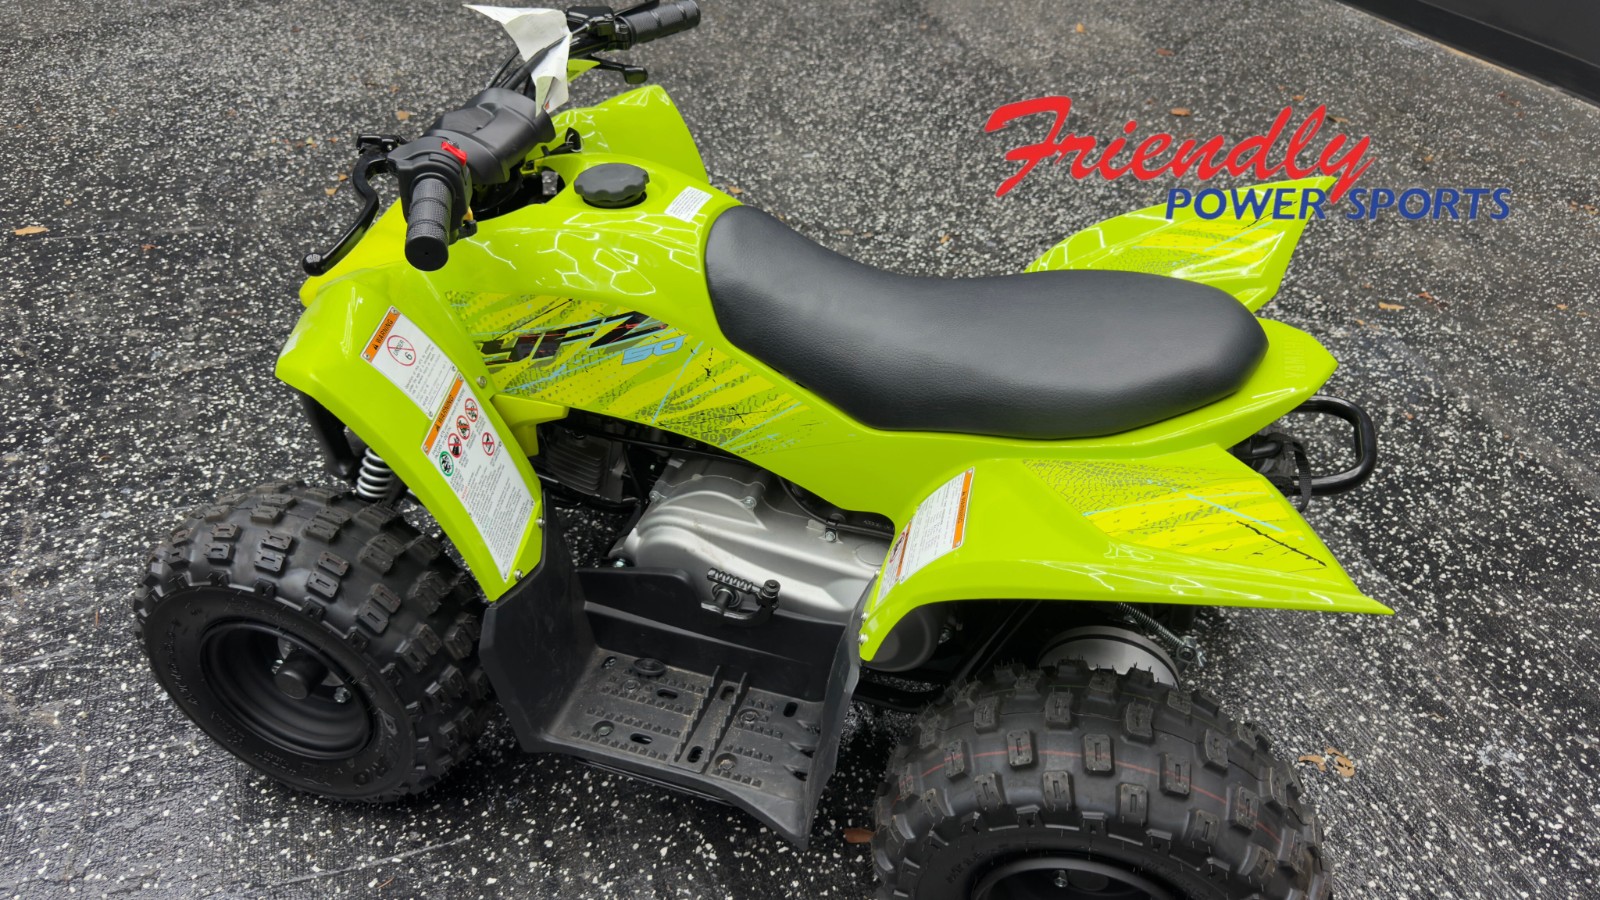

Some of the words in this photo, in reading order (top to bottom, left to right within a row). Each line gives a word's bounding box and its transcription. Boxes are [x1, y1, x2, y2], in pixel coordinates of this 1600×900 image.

[376, 319, 394, 344] WARNING
[404, 351, 413, 360] 6
[621, 335, 688, 365] 50
[438, 394, 454, 423] WARNING
